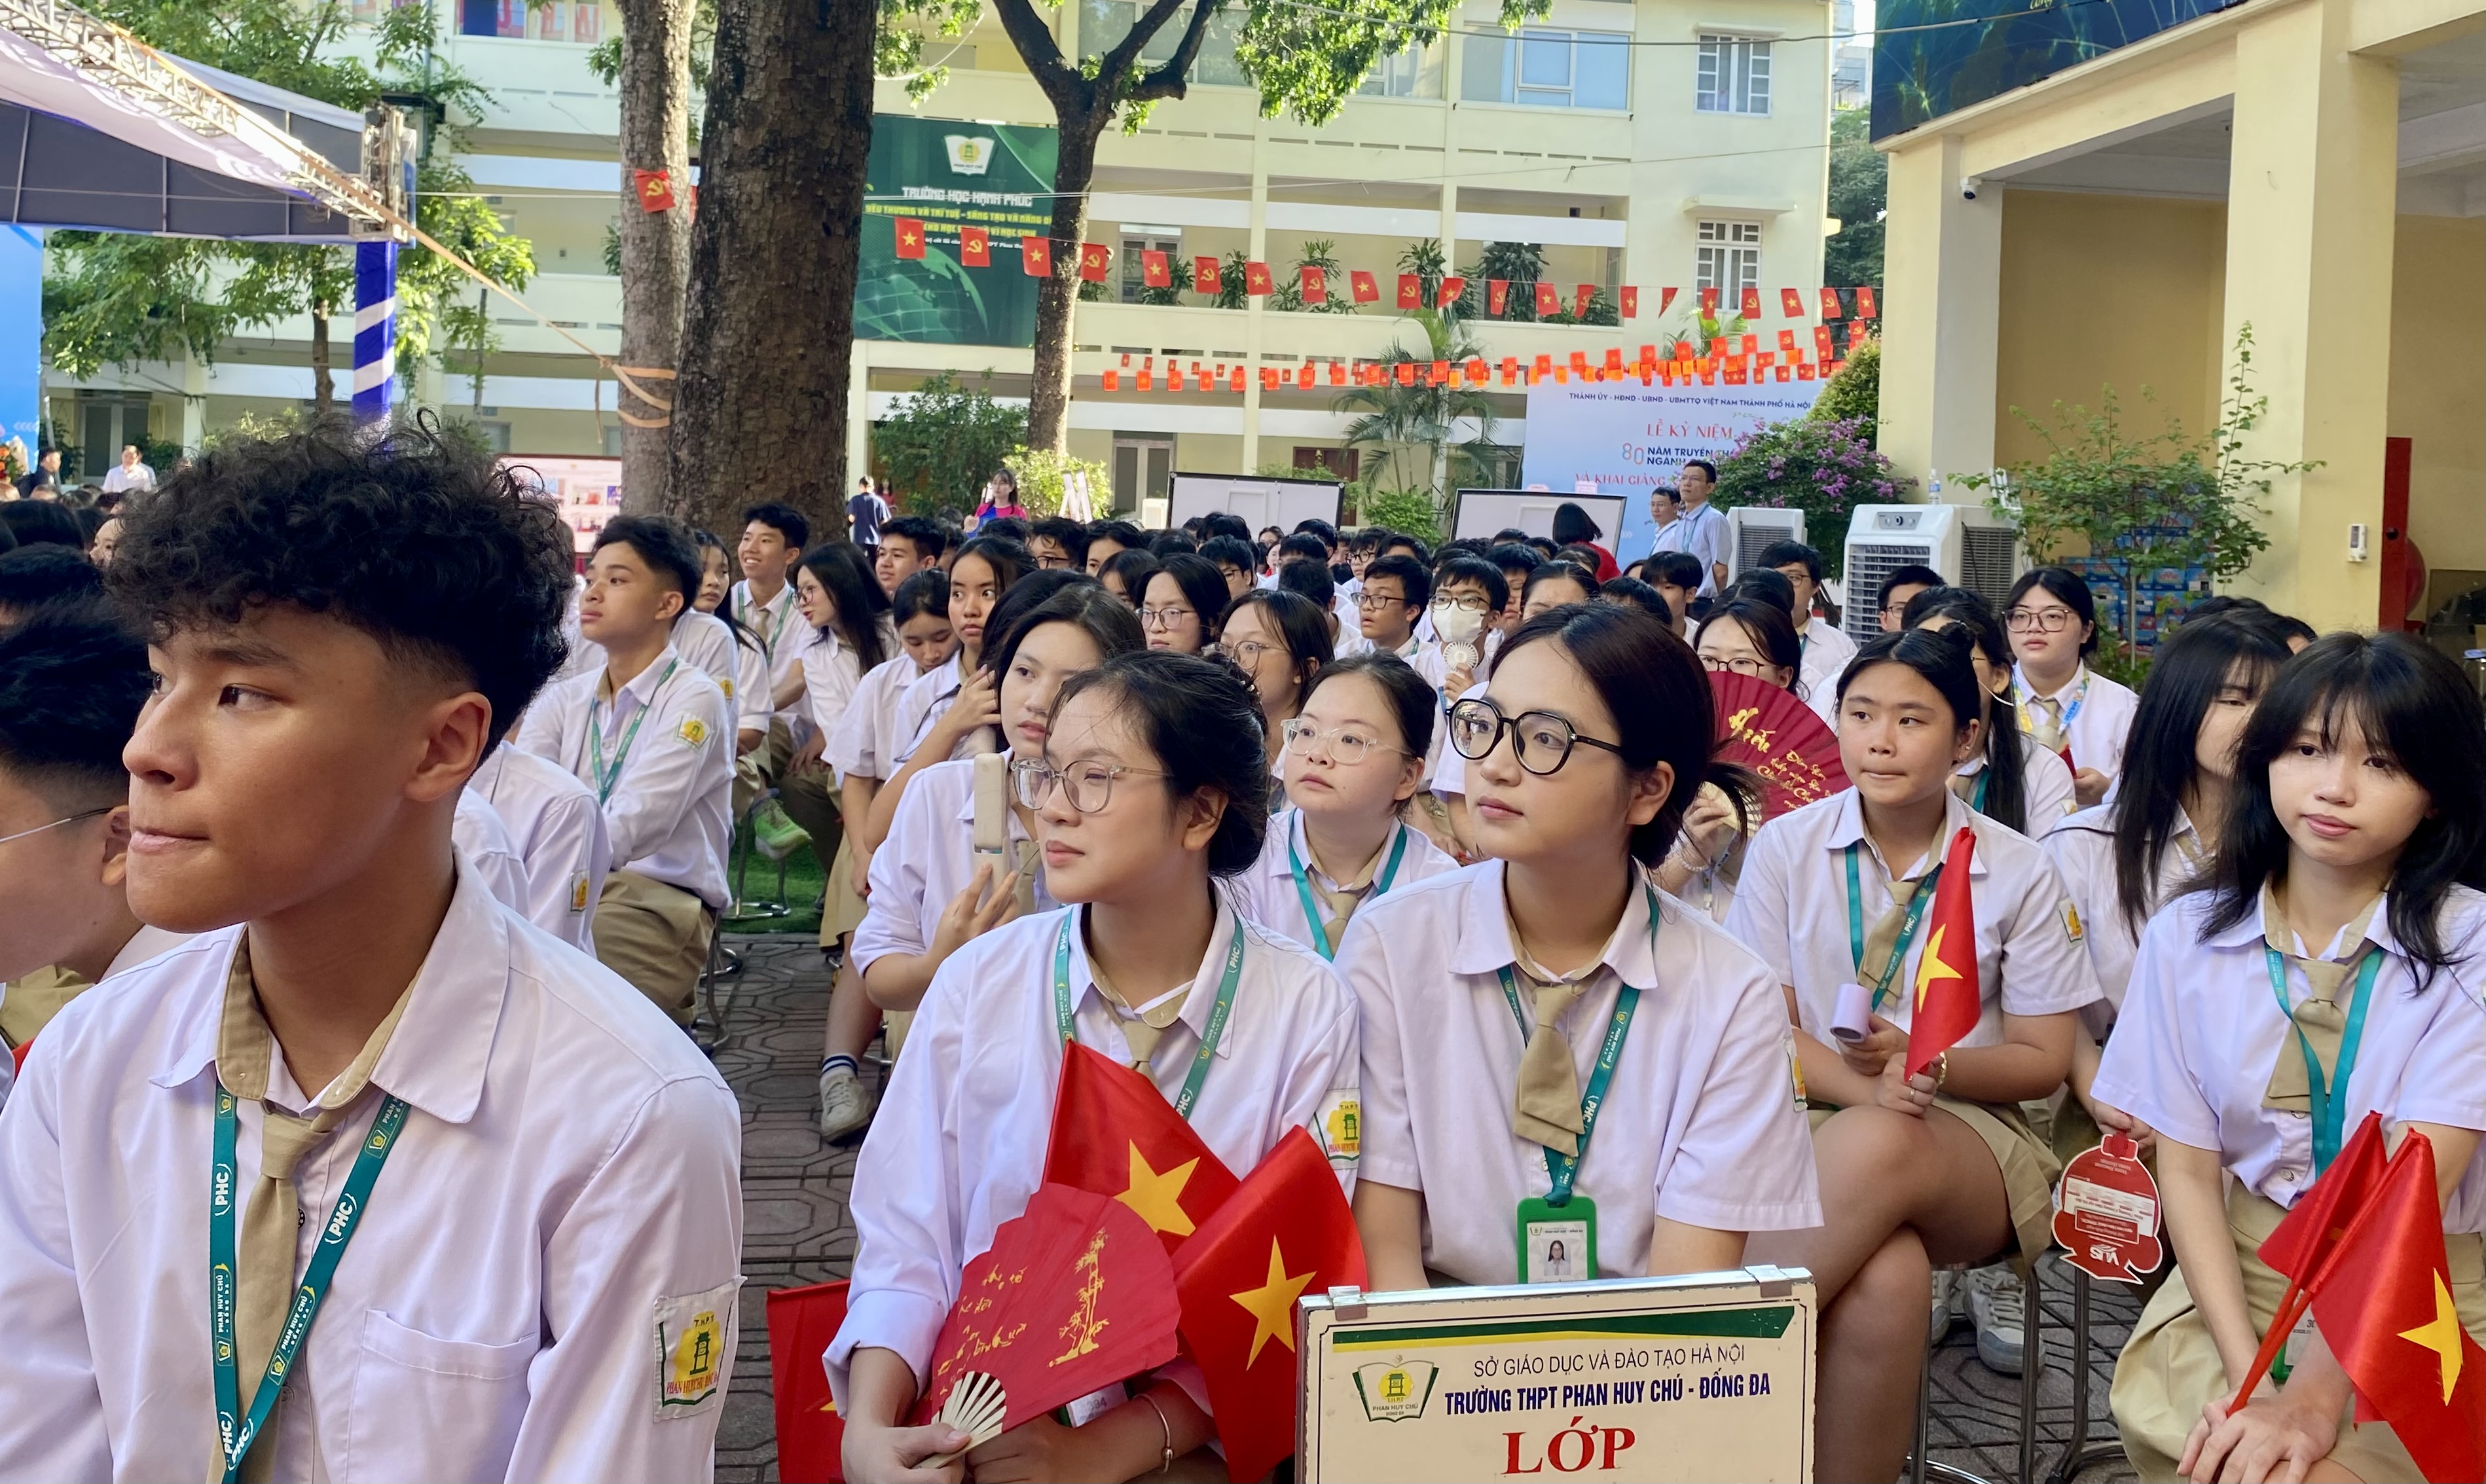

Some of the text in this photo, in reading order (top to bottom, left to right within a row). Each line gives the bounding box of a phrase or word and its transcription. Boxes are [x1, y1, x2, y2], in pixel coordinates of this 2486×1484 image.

[1703, 397, 1719, 407] VIỆT
[1647, 418, 1664, 437] LỄ
[1622, 443, 1644, 465] 80
[1595, 474, 1624, 484] KHAI
[1229, 946, 1241, 969] PHC
[215, 1172, 228, 1206] PHC
[329, 1201, 353, 1237] PHC
[282, 1295, 308, 1350] PHAN HUY CHÚ
[1474, 1343, 1745, 1377] SỞ GIÁO DỤC VÀ ĐÀO TẠO HÀ NỘI
[1445, 1384, 1511, 1415] TRƯỜNG
[1517, 1386, 1558, 1411] THPT
[1562, 1383, 1608, 1408] PHAN
[1613, 1380, 1645, 1405] HUY
[1650, 1373, 1683, 1402] CHÚ
[1699, 1367, 1744, 1399] ĐỐNG
[1749, 1373, 1770, 1396] ĐA
[221, 1420, 233, 1454] PHC
[1501, 1415, 1636, 1475] LỚP
